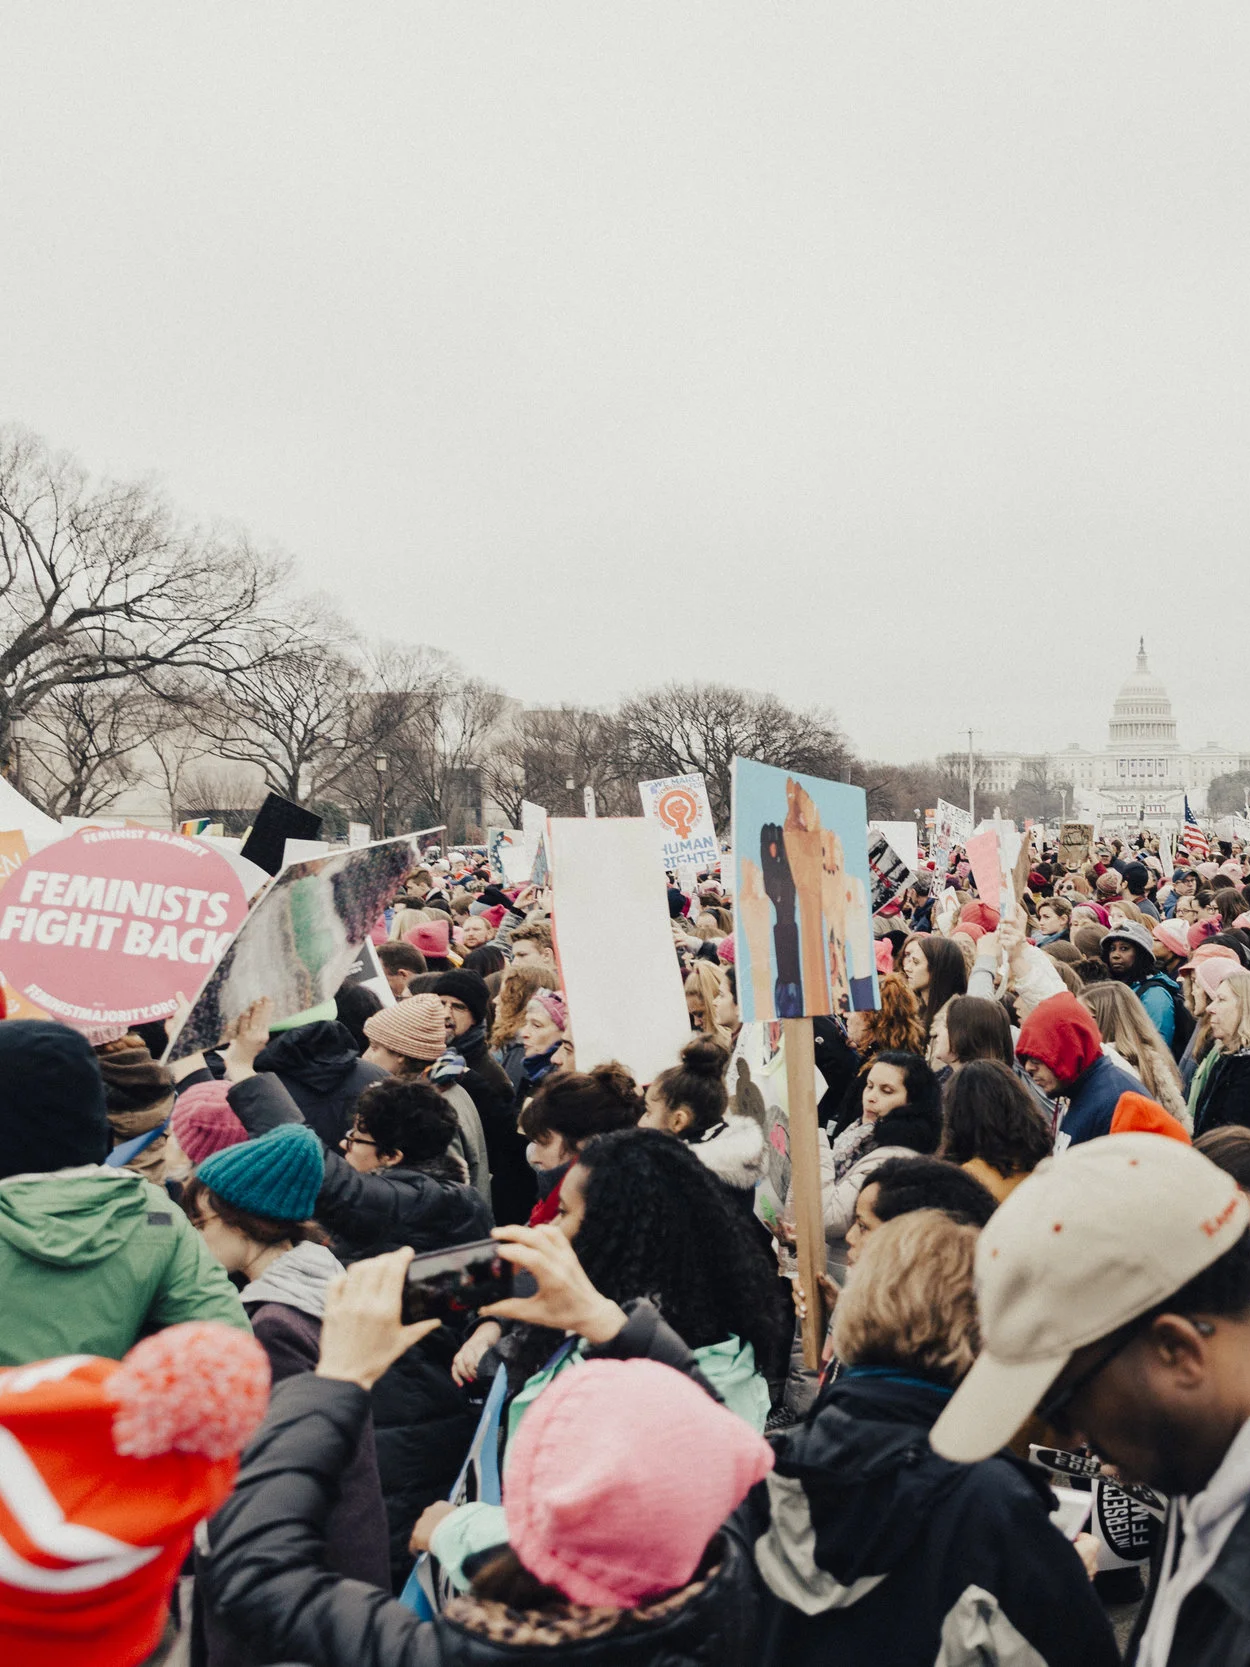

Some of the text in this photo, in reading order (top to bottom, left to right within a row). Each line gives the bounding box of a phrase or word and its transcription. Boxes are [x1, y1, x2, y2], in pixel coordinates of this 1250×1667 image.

[81, 828, 210, 858] FEMINIST MAJORITY
[19, 870, 230, 927] FEMINISTS
[0, 906, 236, 965] FIGHT BACK
[23, 983, 180, 1022] FEMINISTMAJORITY.ORG
